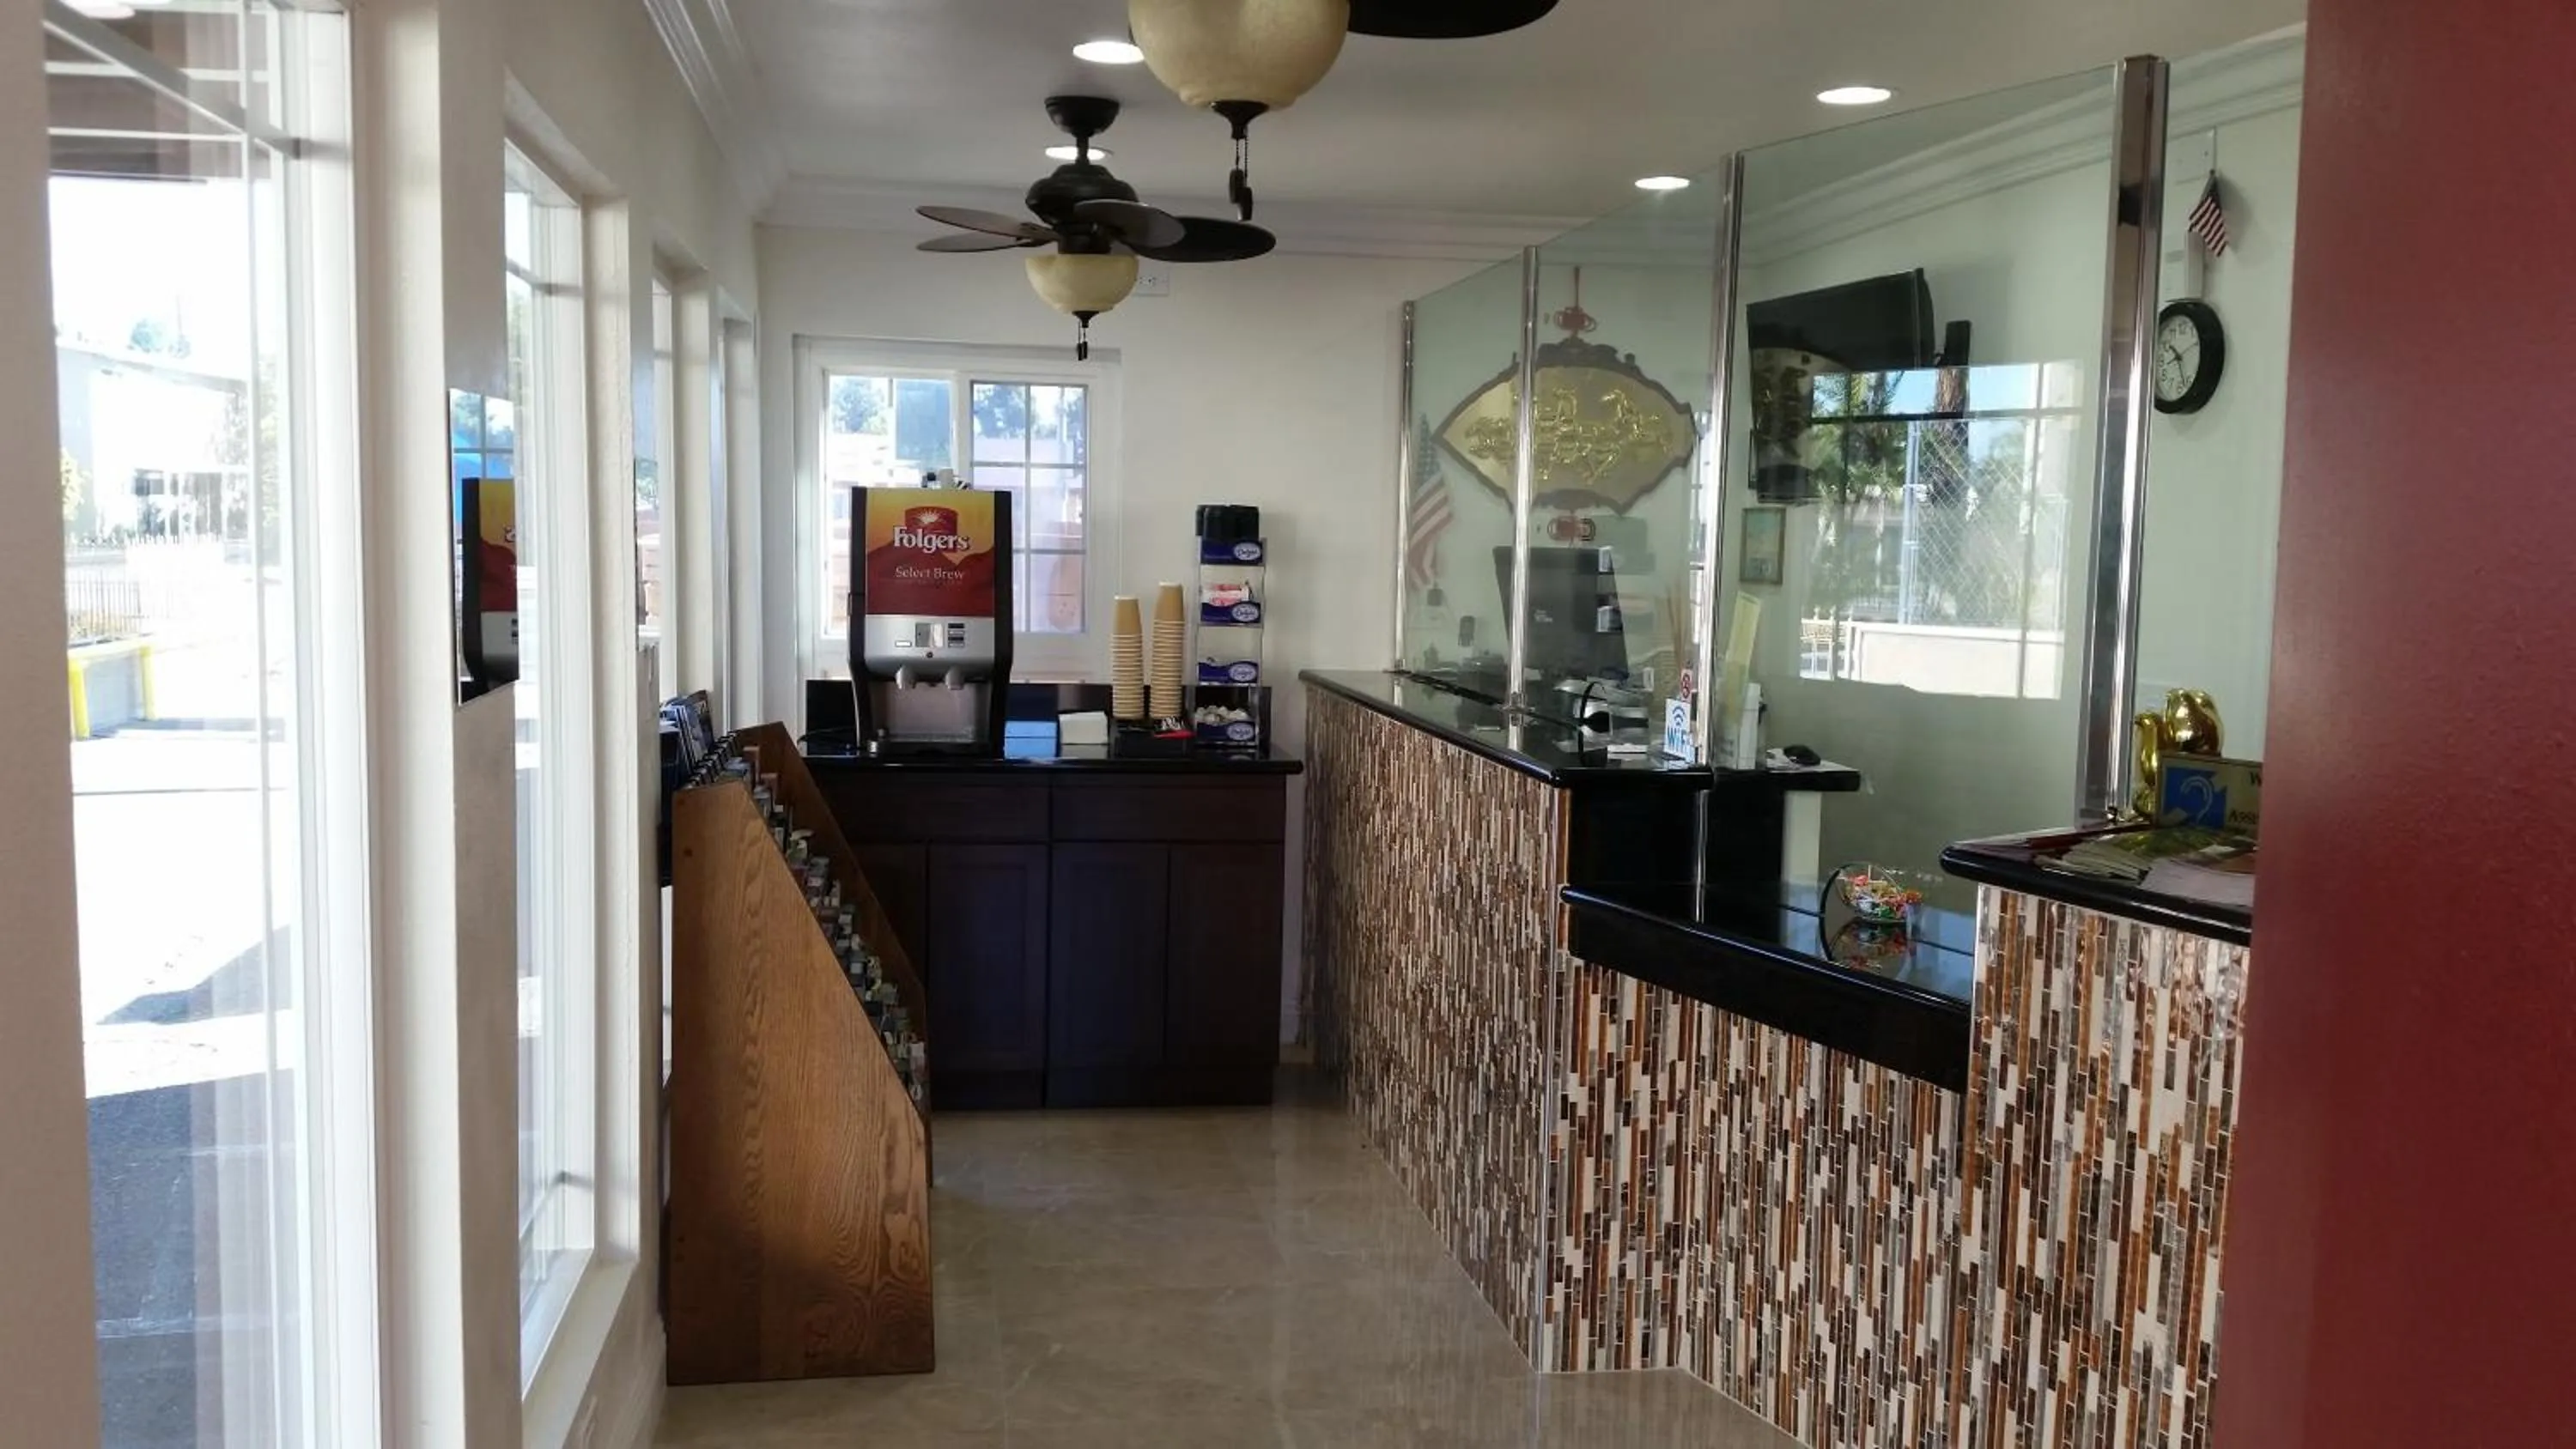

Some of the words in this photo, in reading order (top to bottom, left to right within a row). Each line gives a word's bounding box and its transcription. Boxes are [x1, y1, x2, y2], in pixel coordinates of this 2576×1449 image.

[894, 526, 969, 554] Folgers
[896, 566, 930, 578] Select
[933, 567, 963, 579] Brew
